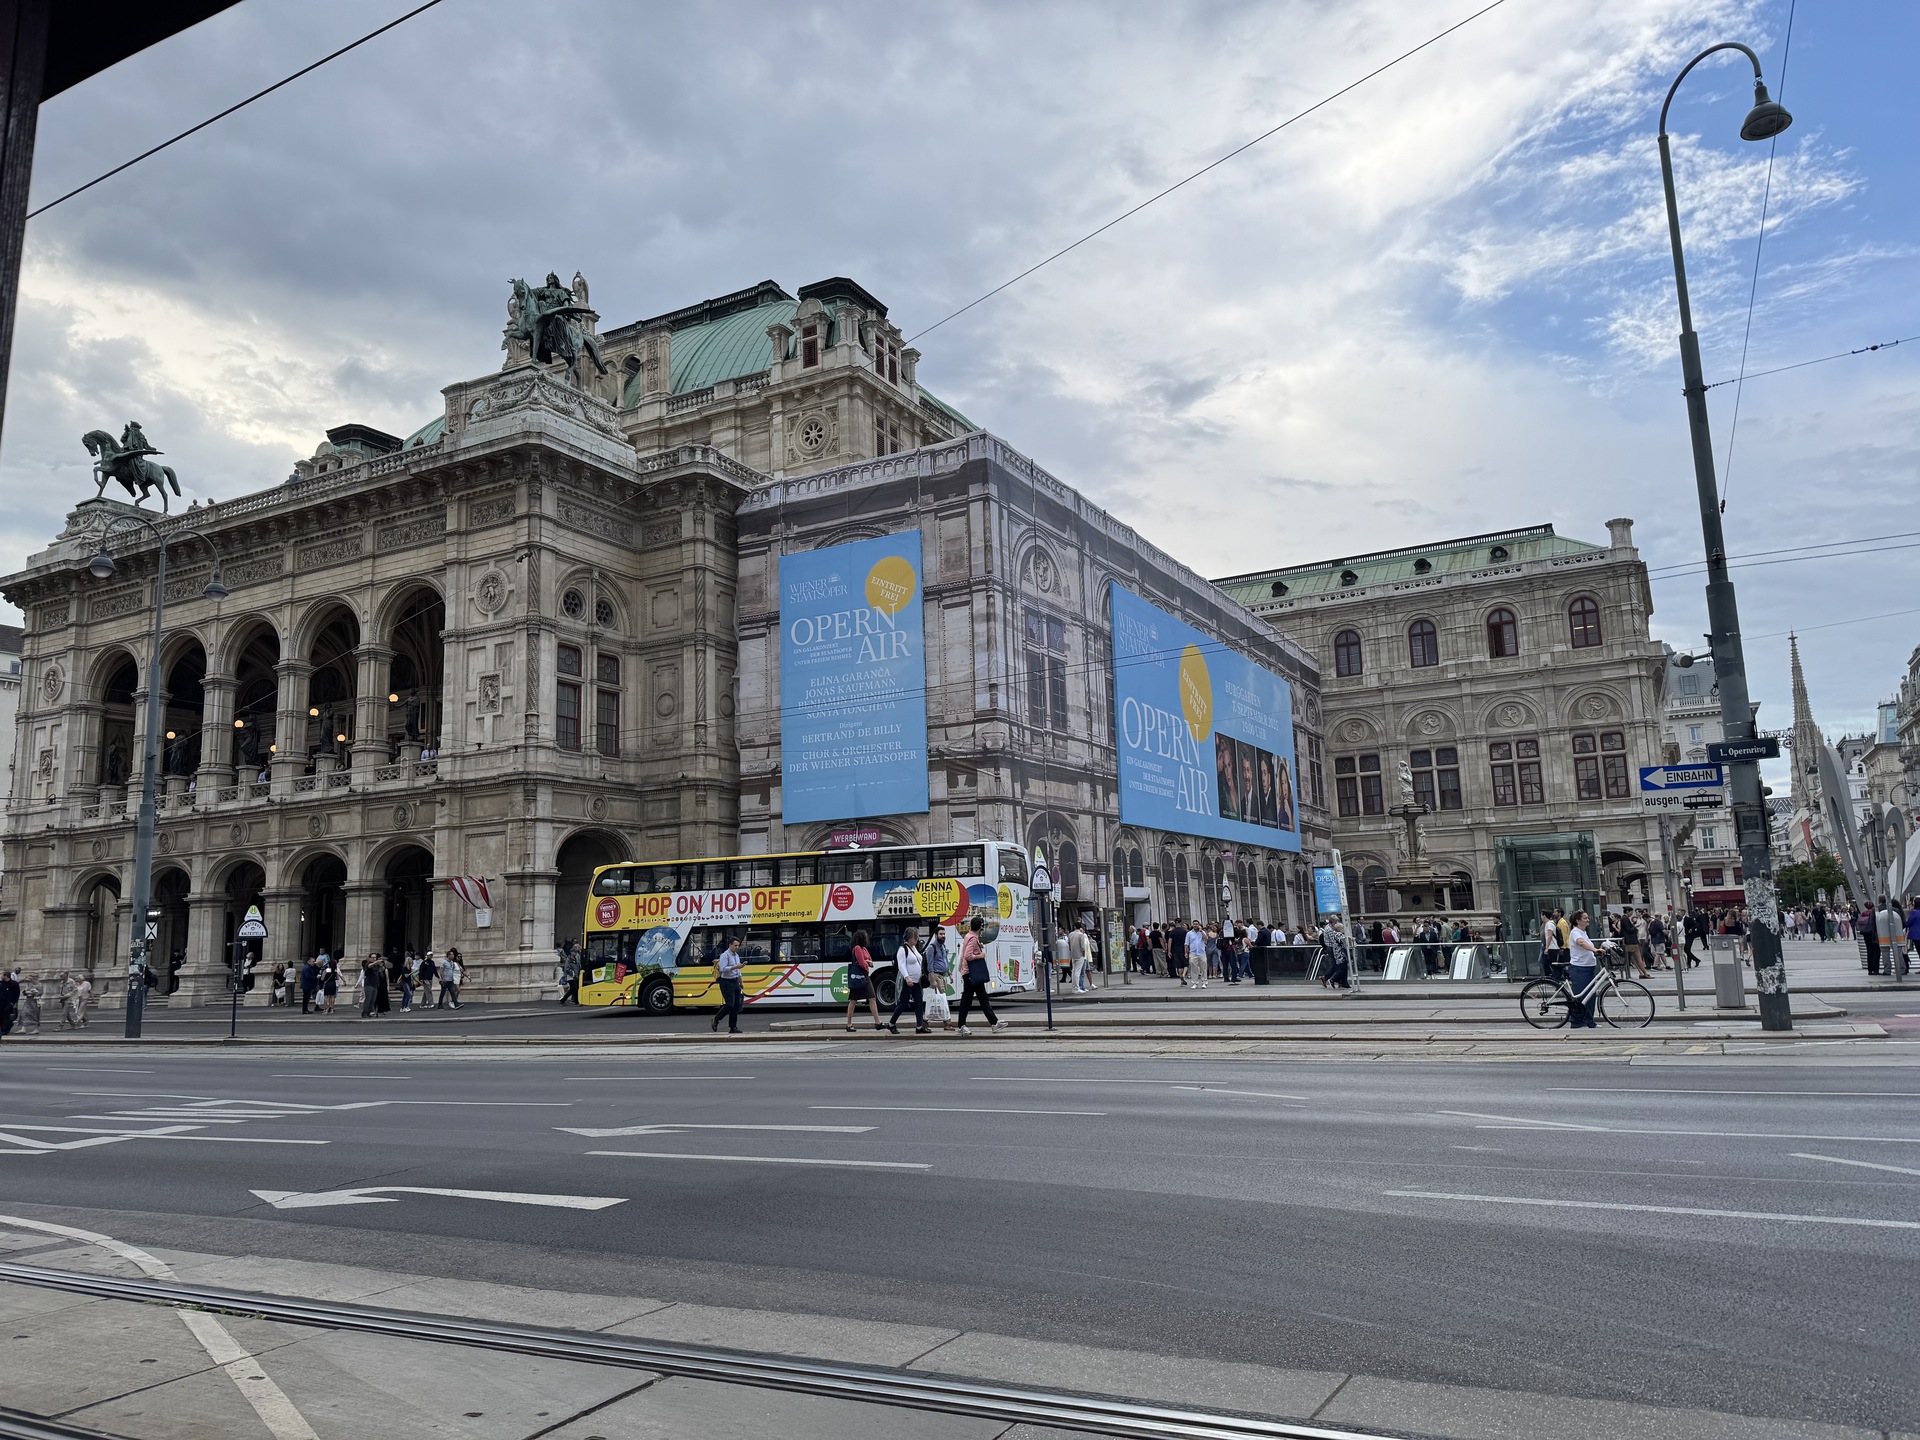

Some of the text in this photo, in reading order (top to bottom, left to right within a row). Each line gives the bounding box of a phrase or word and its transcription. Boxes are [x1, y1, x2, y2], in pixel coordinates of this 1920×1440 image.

[789, 579, 828, 594] WIENER
[790, 584, 848, 604] STAATSOPER
[871, 576, 908, 595] EINTRITT
[880, 589, 899, 602] FREI
[790, 602, 898, 646] OPERN
[1118, 611, 1149, 643] WIENER
[821, 647, 852, 657] STAATSOPER
[855, 630, 912, 664] AIR
[798, 687, 905, 710] BENJAMIN BERNHEIM
[805, 678, 896, 700] JONAS KAUFMANN
[1183, 668, 1207, 714] EINTRITT
[806, 701, 896, 720] SONYA YONCHEVA
[1237, 702, 1268, 727] SEPTEMBER
[802, 723, 902, 744] BERTRAND DE BILLY
[839, 721, 863, 729] Dirigent
[1123, 696, 1200, 768] OPERN
[802, 741, 902, 760] CHOR & ORCHESTER
[1728, 745, 1767, 758] Opernring
[789, 750, 917, 773] DER WIENER STAATSOPER
[1666, 770, 1713, 783] EINBAHN
[1175, 764, 1212, 816] AIR
[1645, 796, 1682, 809] ausgen.
[834, 832, 877, 843] WERBEWAND
[916, 881, 953, 892] VIENNA
[635, 889, 792, 917] HOP ON HOP OFF
[921, 892, 952, 902] SIGHT
[921, 901, 959, 912] SEEING
[736, 910, 813, 920] www.viennasightseeing.at
